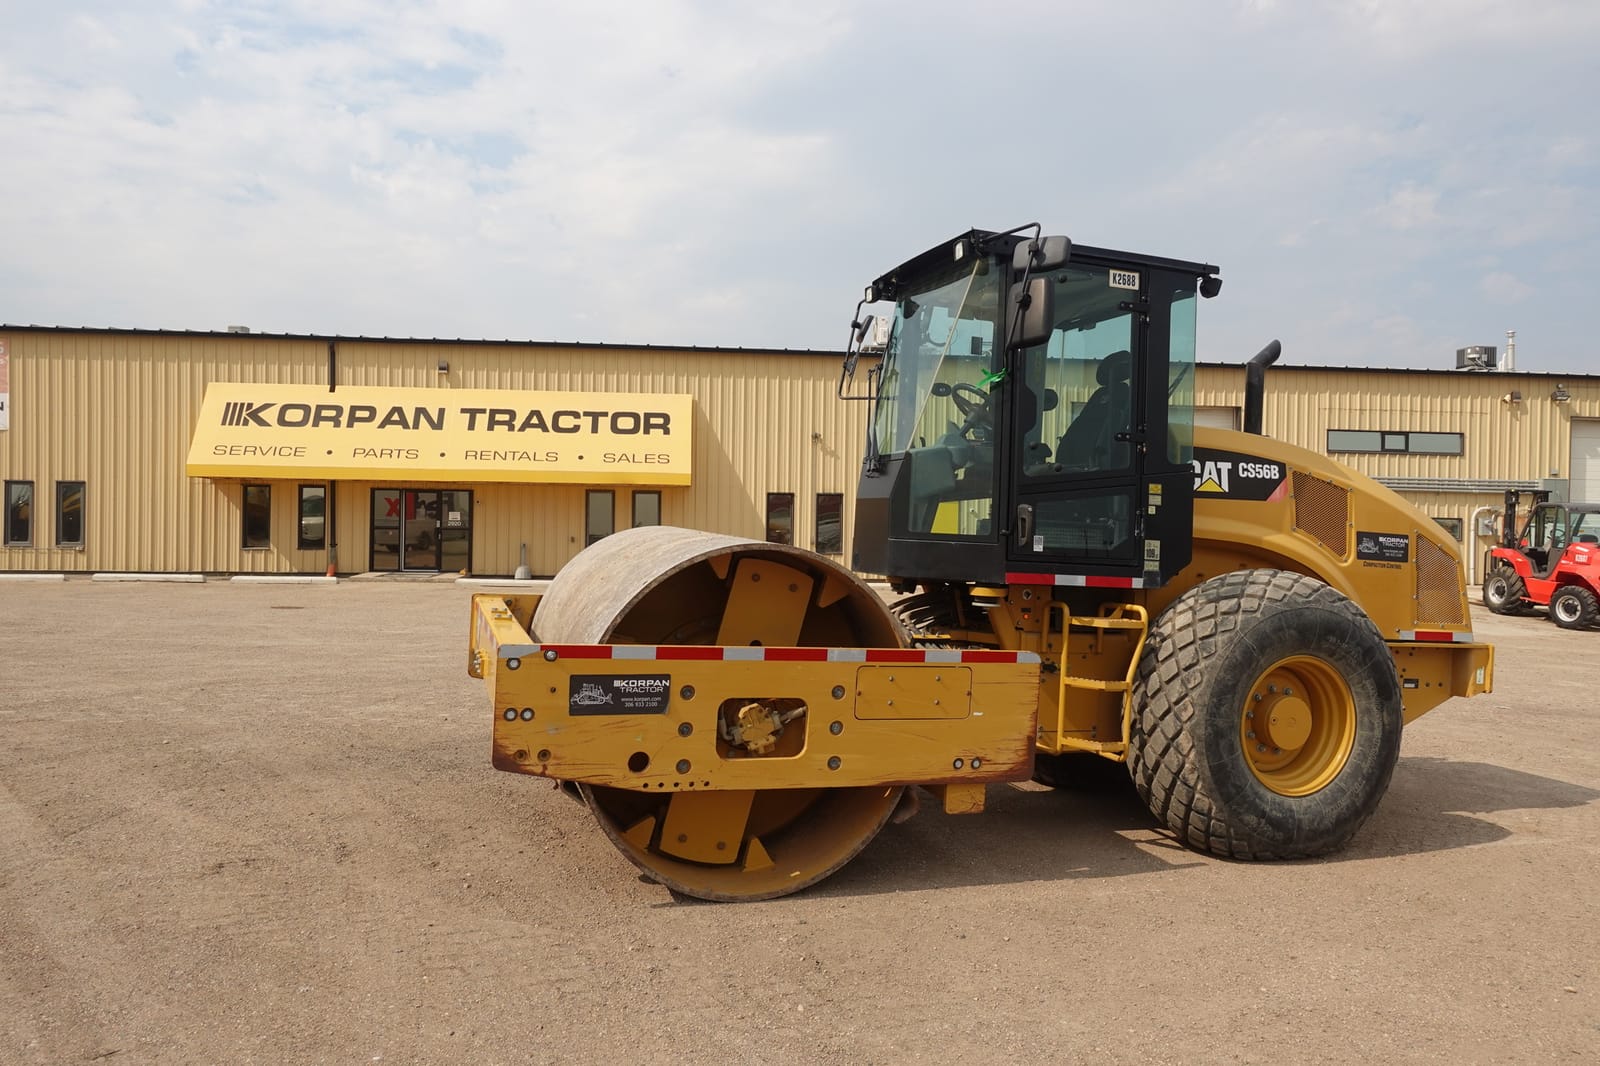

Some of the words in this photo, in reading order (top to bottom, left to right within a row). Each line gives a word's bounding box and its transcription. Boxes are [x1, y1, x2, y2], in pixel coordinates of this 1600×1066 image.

[1112, 272, 1136, 286] K2688
[220, 402, 446, 431] KORPAN
[460, 408, 671, 435] TRACTOR
[213, 445, 307, 457] SERVICE
[352, 448, 419, 460] PARTS
[465, 450, 559, 462] RENTALS
[603, 453, 671, 464] SALES
[1193, 460, 1232, 492] CAT
[1239, 462, 1280, 479] CS56B
[614, 679, 669, 687] KORPAN
